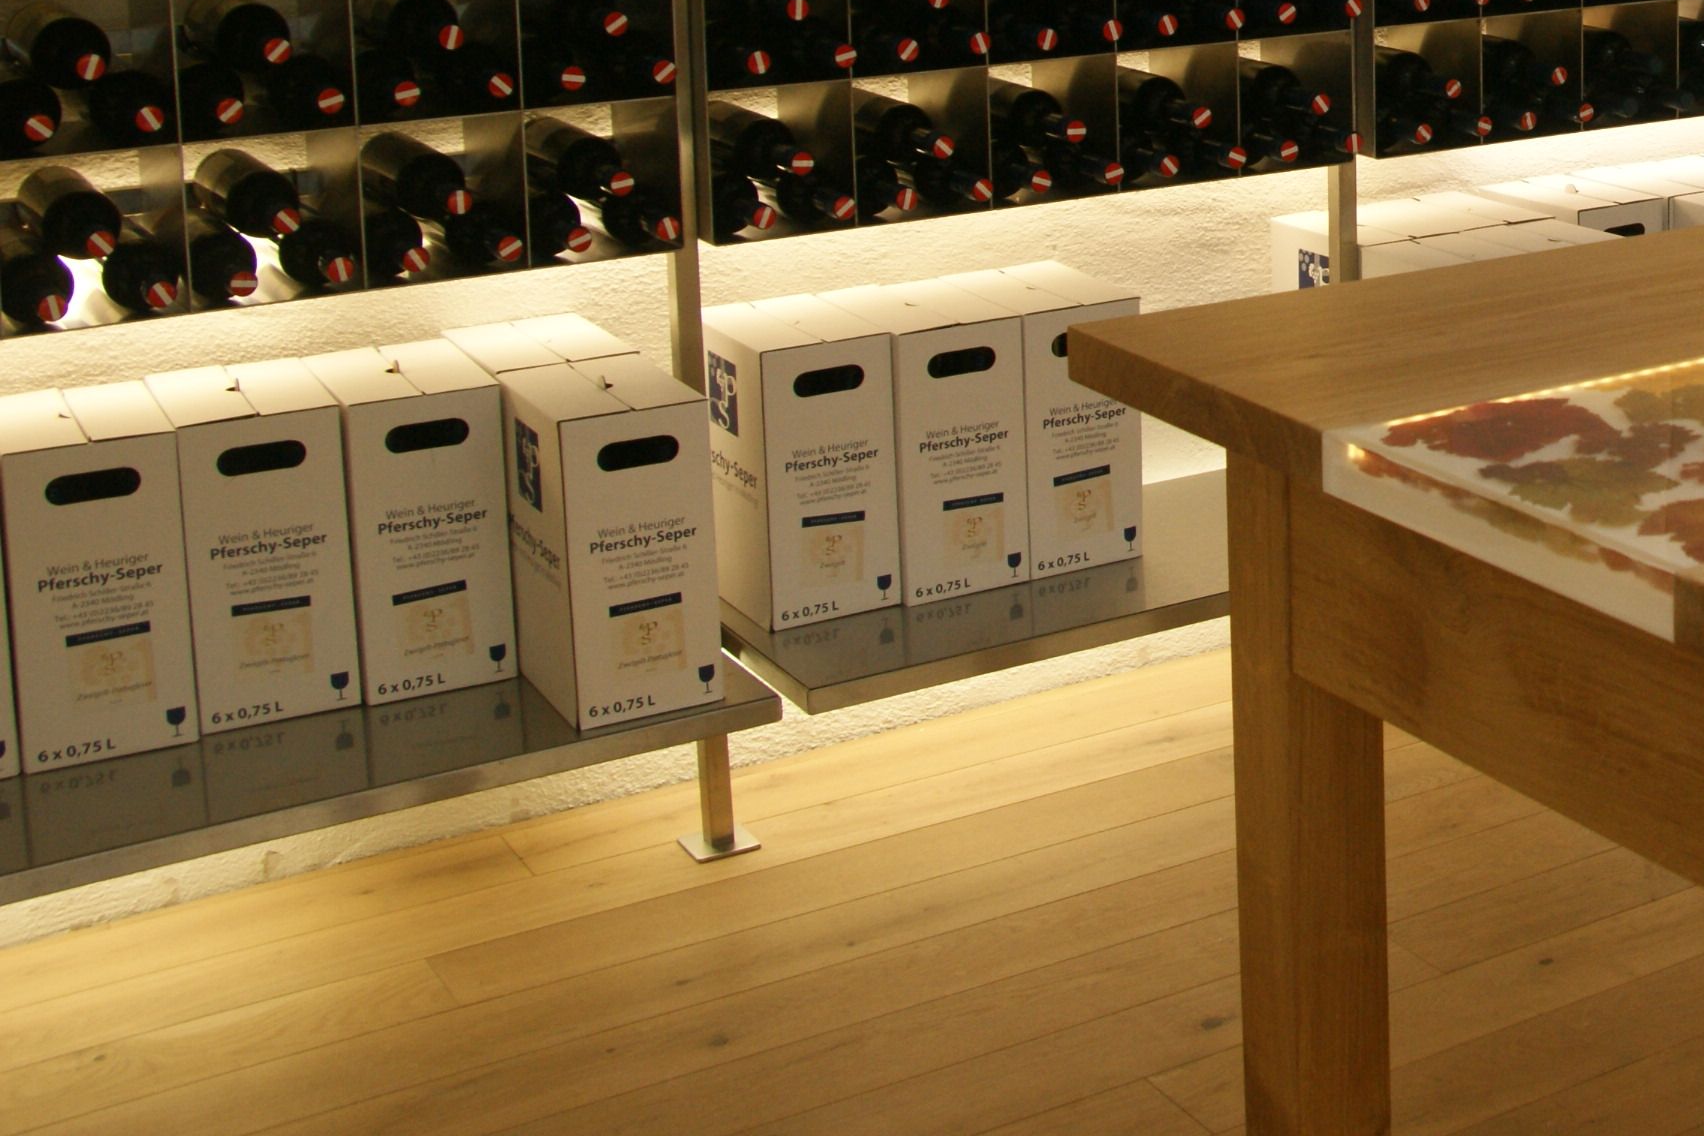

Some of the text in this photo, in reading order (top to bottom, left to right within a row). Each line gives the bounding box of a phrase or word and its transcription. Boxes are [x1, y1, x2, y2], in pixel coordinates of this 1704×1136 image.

[1042, 408, 1126, 429] Pferschy-Seper
[1048, 405, 1071, 417] Wein
[1072, 402, 1079, 413] &
[919, 430, 1008, 453] Pferschy-Seper
[925, 420, 999, 440] Wein & Heuriger
[791, 438, 868, 459] Wein & Heuriger
[712, 450, 758, 488] schy-Seper
[784, 449, 878, 473] Pferschy-Seper
[385, 499, 475, 521] Wein & Heuriger
[218, 522, 314, 545] Wein & Heuriger
[377, 509, 487, 535] Pferschy-Seper
[597, 515, 685, 539] Wein & Heuriger
[209, 534, 327, 561] Pferschy-Seper
[589, 527, 697, 554] Pferschy-Seper
[46, 552, 149, 577] Wein & Heuriger
[1037, 560, 1045, 571] 6
[1056, 553, 1081, 567] 0,75
[1083, 551, 1090, 562] L
[37, 564, 162, 593] Pferschy-Seper
[915, 577, 971, 598] 6 x 0,75 L
[781, 600, 839, 621] 6 x 0,75 L
[377, 672, 446, 695] 6 x 0,75 L
[211, 700, 284, 724] 6 x 0,75 L
[588, 695, 656, 718] 6 x 0,75 L
[37, 738, 116, 762] 6 x 0,75 L
